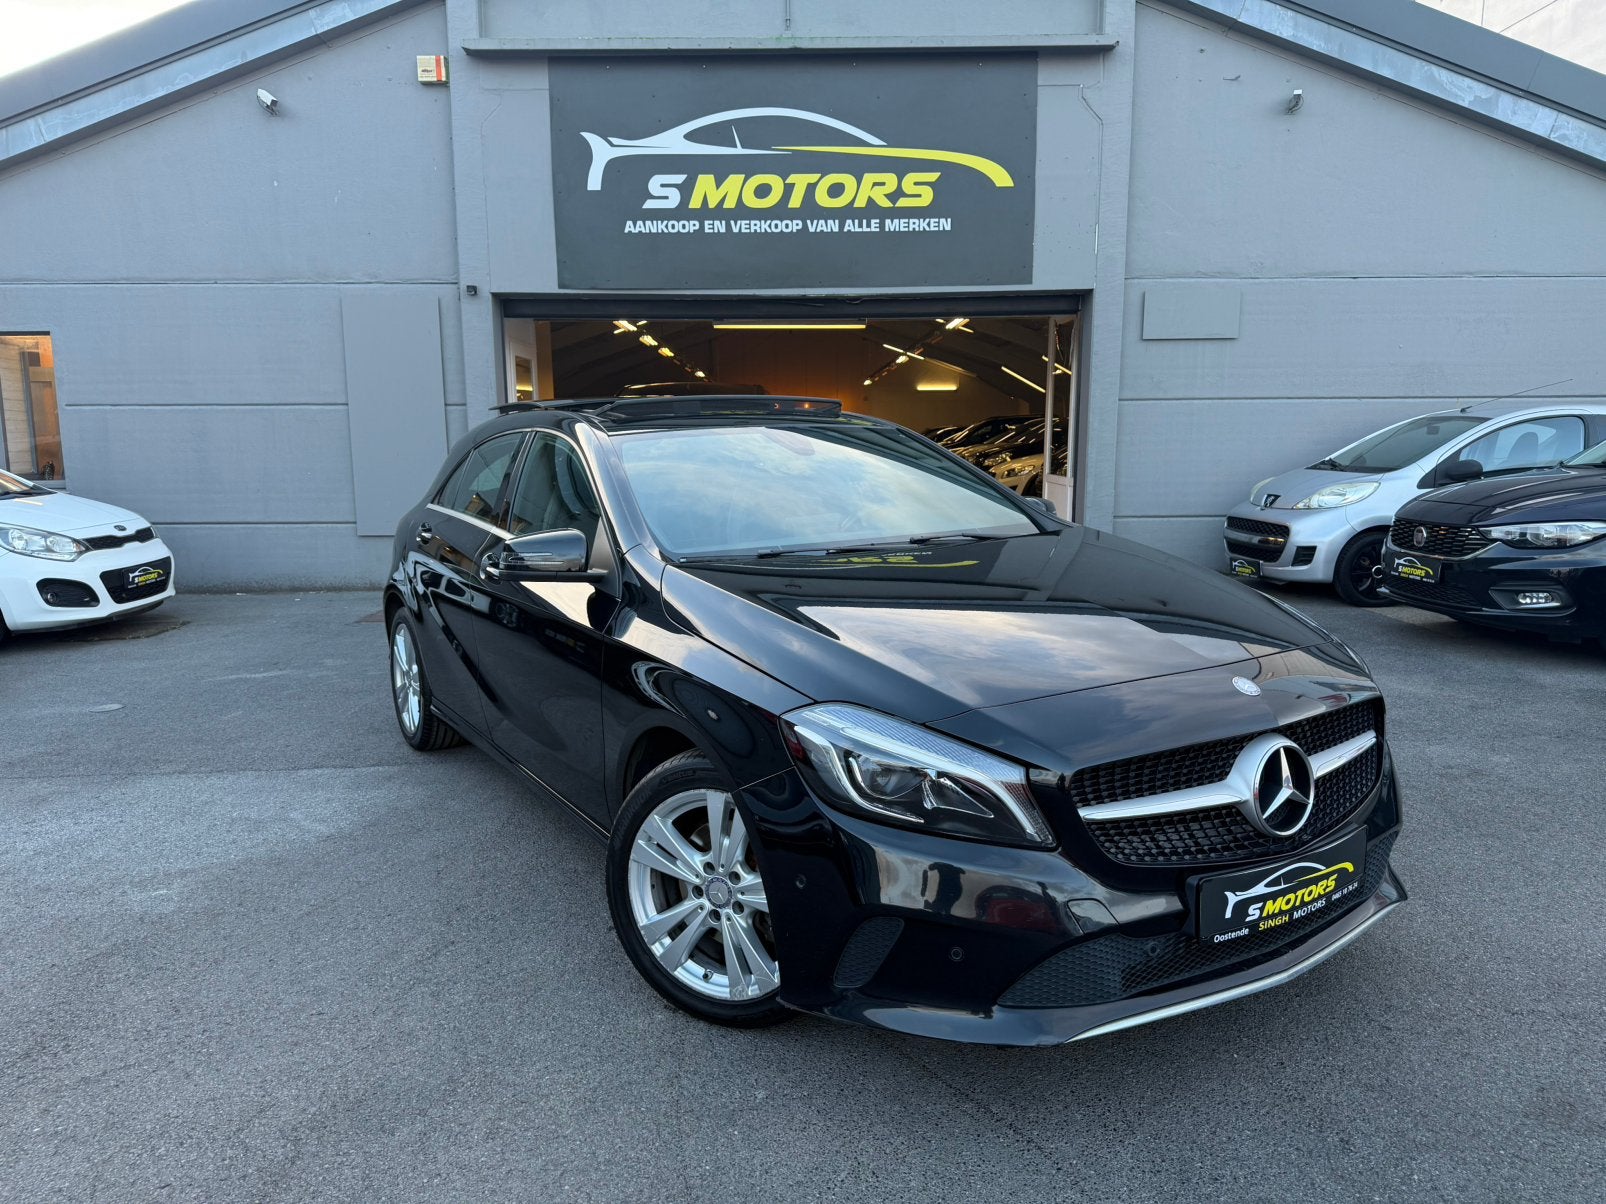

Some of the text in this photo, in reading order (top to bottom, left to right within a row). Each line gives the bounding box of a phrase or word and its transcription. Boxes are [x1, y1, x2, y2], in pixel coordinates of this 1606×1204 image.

[624, 218, 952, 233] AANKOOP EN VERKOOP VAN ALLE MERKEN
[1213, 927, 1249, 943] Oostende
[1259, 914, 1289, 931] SINGH
[1293, 898, 1326, 919] MOTORS
